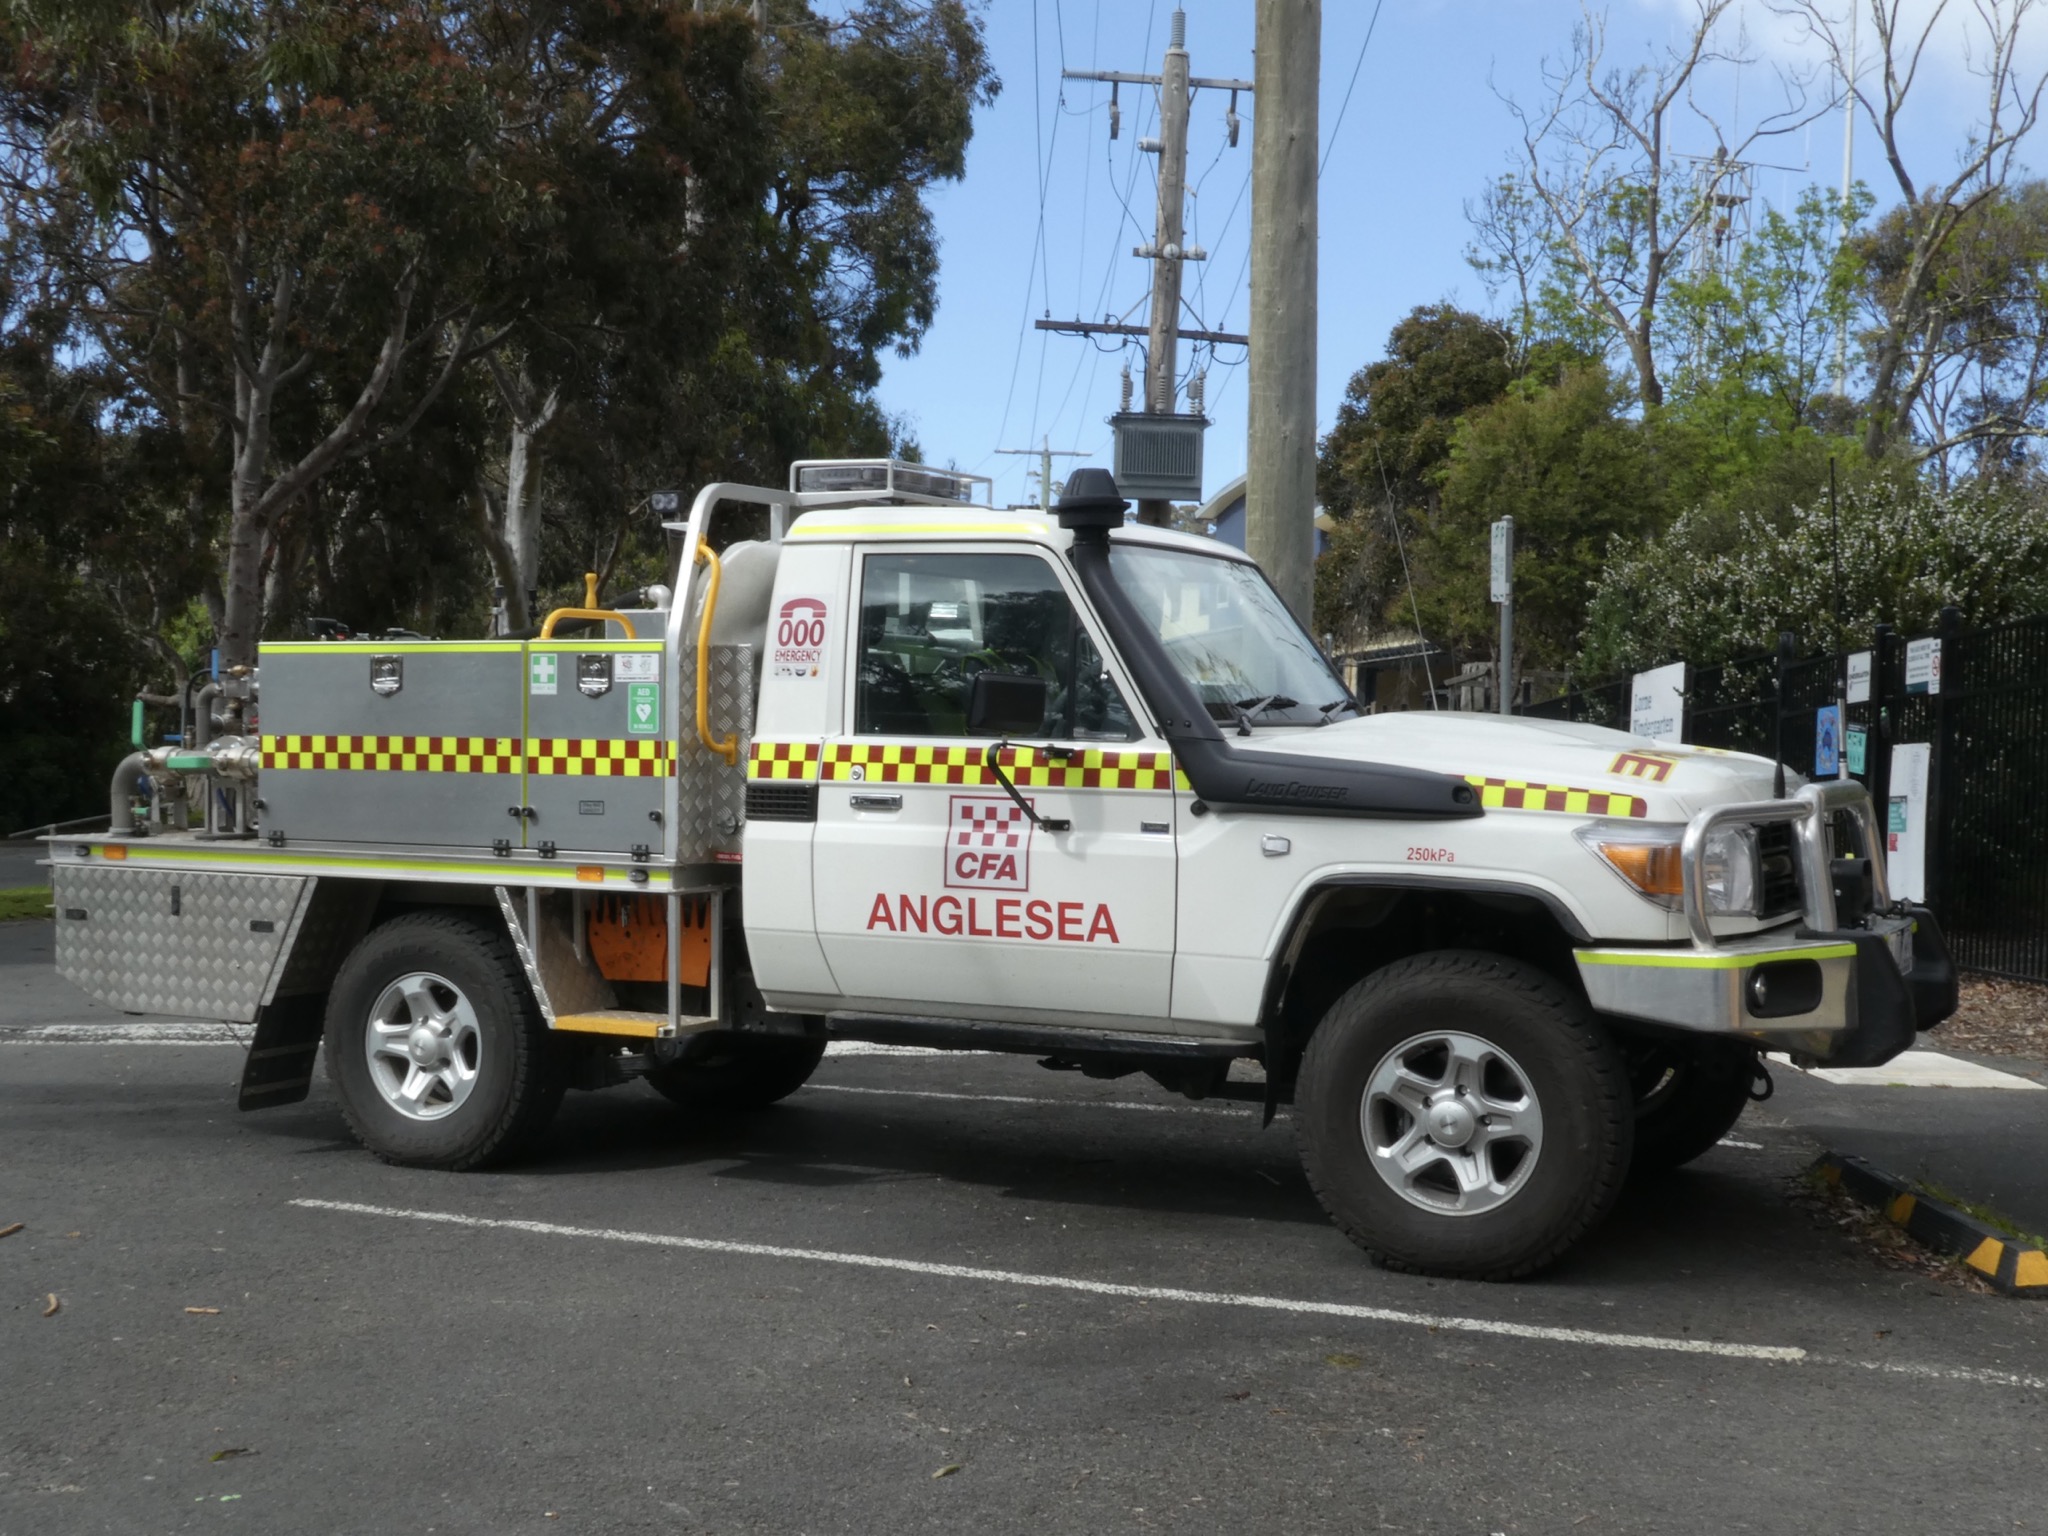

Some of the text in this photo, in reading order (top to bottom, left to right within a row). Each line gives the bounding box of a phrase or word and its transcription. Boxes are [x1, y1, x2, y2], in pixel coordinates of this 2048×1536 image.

[778, 619, 825, 647] 000
[775, 649, 822, 662] EMERGENCY
[637, 687, 650, 696] AED
[1633, 717, 1673, 739] Kindergarten
[1406, 847, 1454, 862] 250kPa
[955, 852, 1018, 880] CFA
[866, 893, 1120, 943] ANGLESEA
